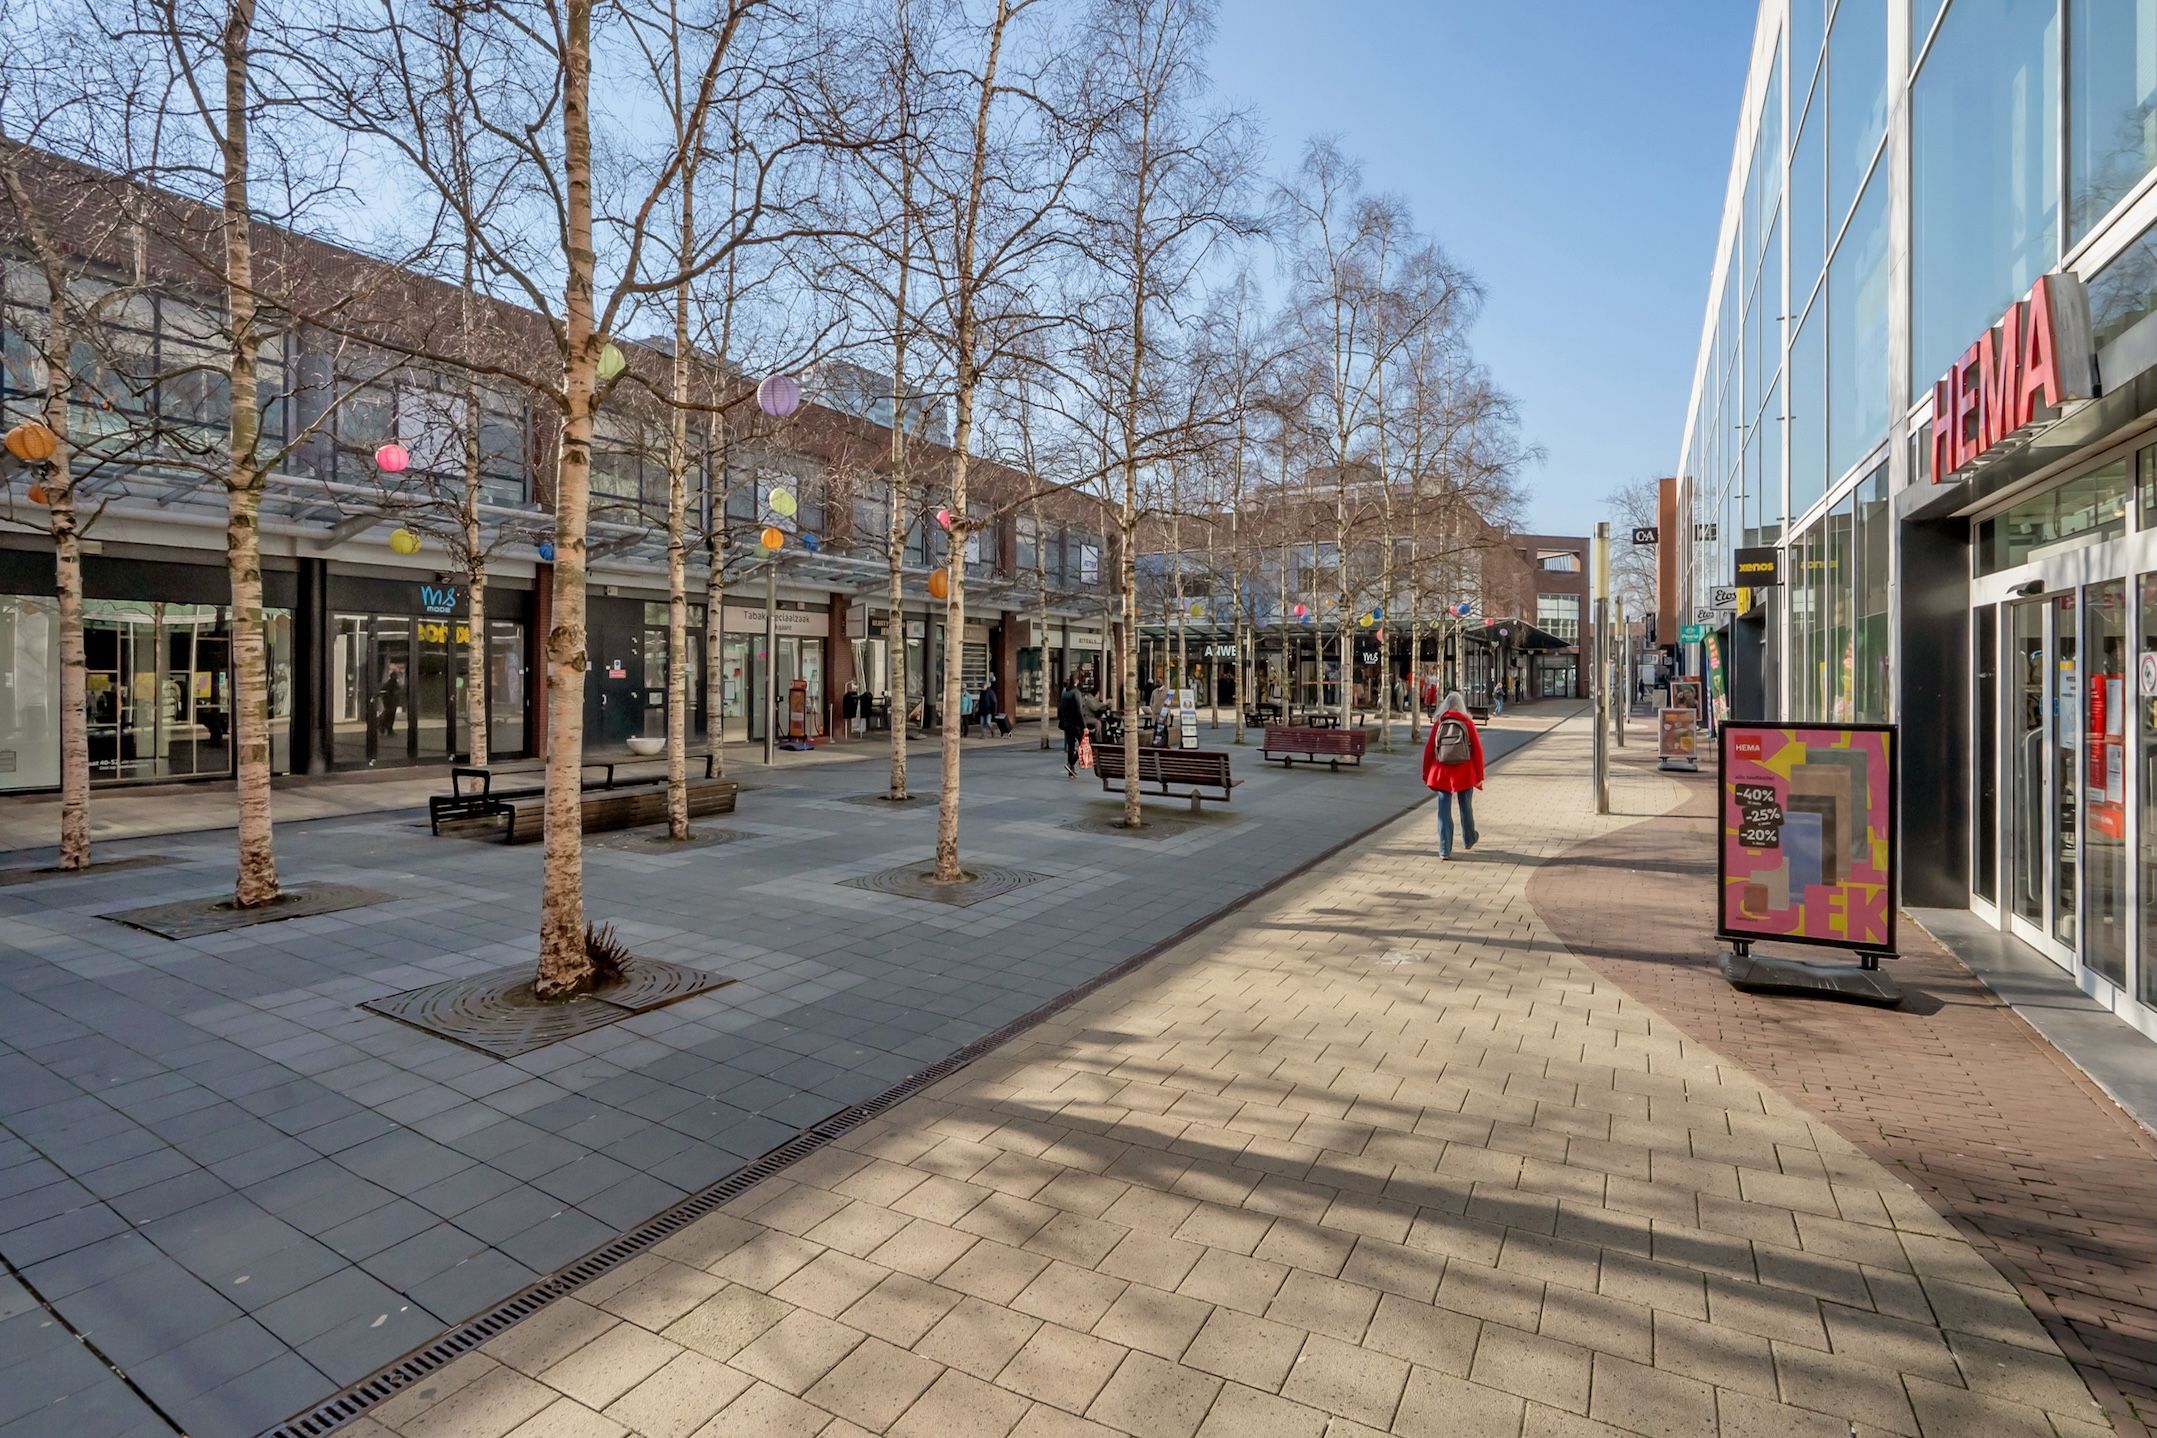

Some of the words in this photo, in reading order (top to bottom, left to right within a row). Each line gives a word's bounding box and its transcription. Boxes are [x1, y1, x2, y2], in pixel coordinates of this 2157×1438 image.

[1931, 273, 2062, 485] HEMA
[1636, 530, 1655, 542] C&A
[1738, 562, 1774, 572] xenos
[1715, 589, 1737, 602] Etos
[743, 610, 810, 623] Tabakeciaalzaak
[1697, 610, 1715, 619] Etos
[1736, 788, 1774, 802] -40%
[1745, 807, 1781, 823] -25%
[1740, 829, 1777, 842] -20%
